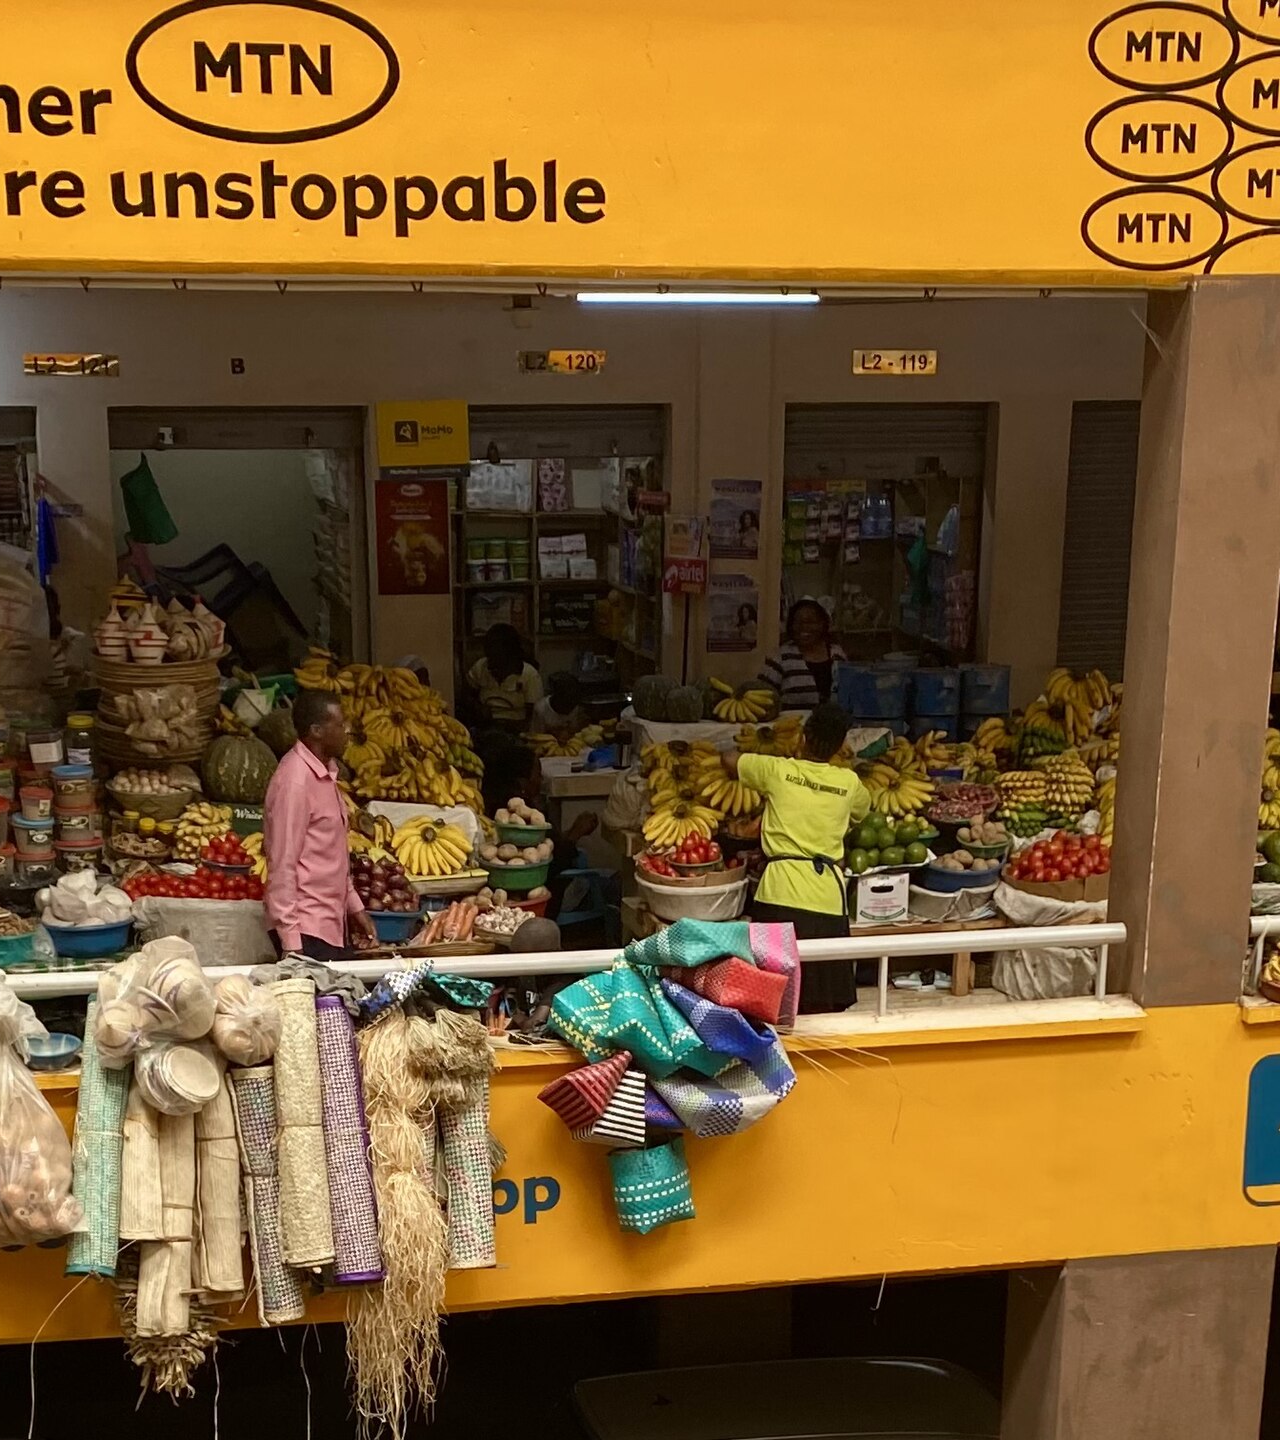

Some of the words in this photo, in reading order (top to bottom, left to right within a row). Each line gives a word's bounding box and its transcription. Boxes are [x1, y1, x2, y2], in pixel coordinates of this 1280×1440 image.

[1125, 31, 1202, 63] MTN
[192, 41, 333, 96] MTN
[1121, 123, 1197, 154] MTN
[110, 159, 606, 237] unstoppable
[1116, 213, 1192, 243] MTN
[230, 357, 245, 375] B
[525, 355, 546, 371] L2
[566, 354, 597, 371] 120
[861, 354, 881, 371] L2
[900, 355, 928, 371] 119
[679, 563, 705, 583] airtel
